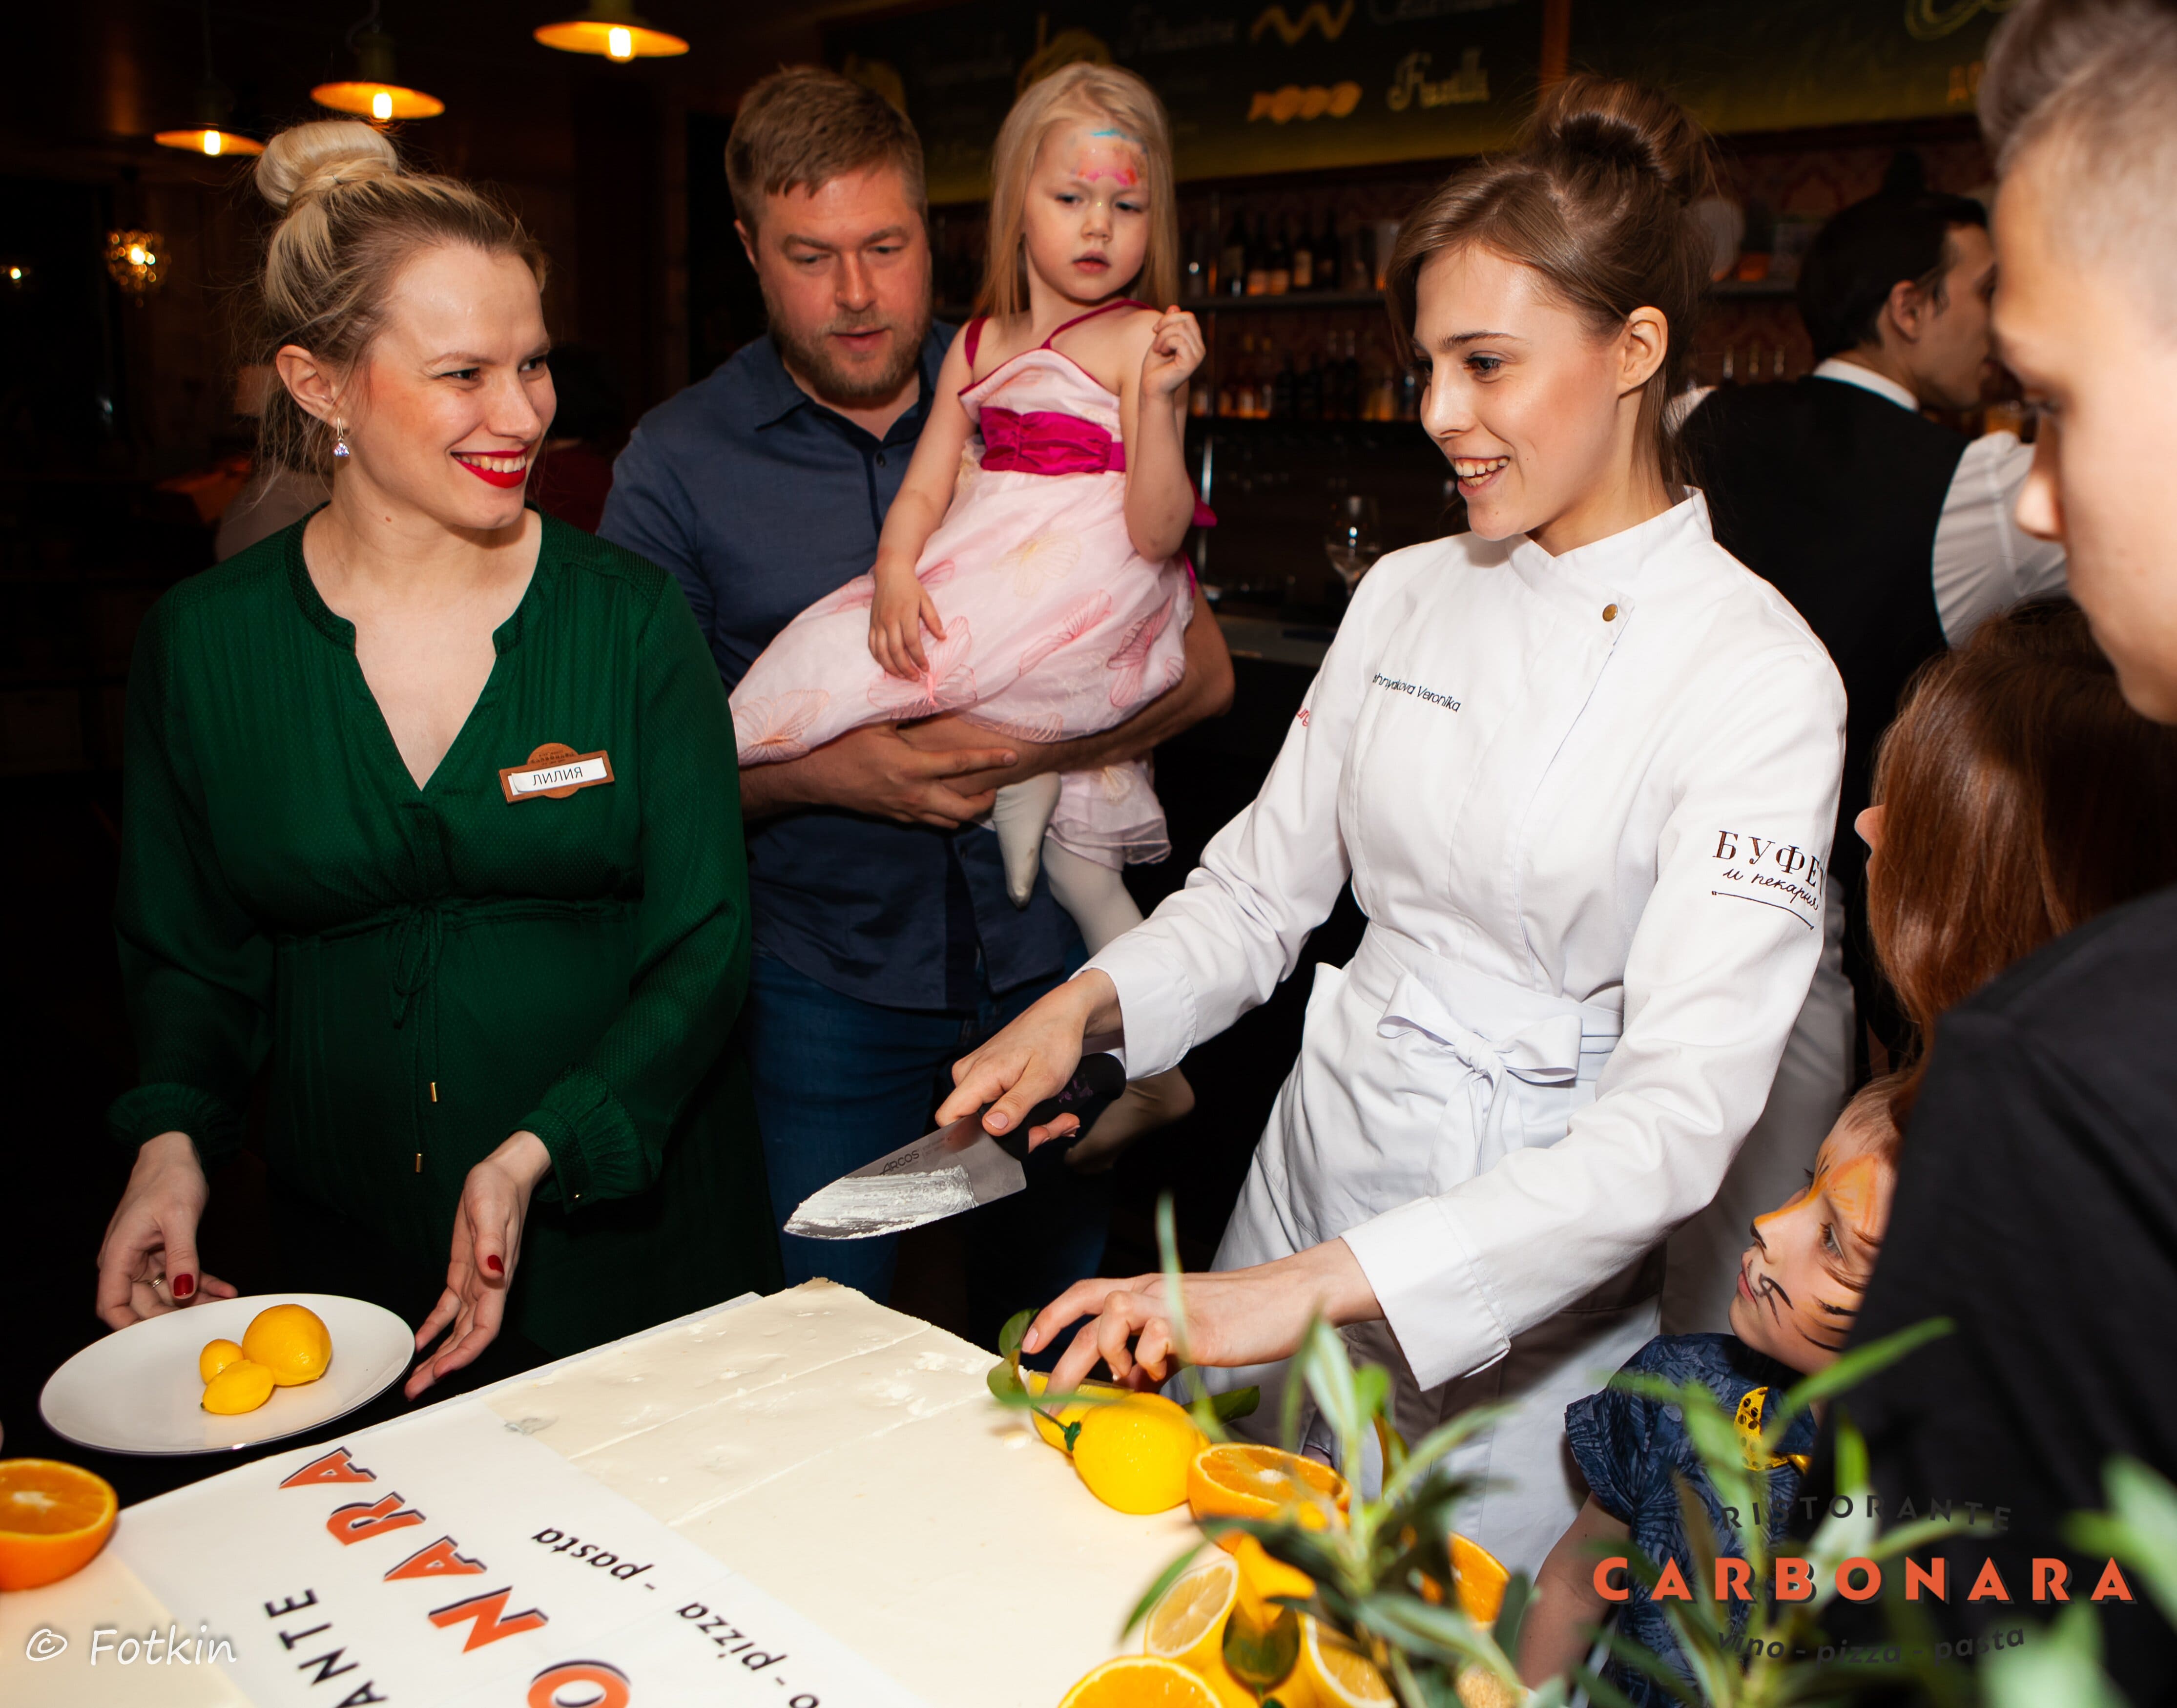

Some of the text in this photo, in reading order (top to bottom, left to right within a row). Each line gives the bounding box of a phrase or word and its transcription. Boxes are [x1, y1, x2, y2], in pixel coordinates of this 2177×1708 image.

[1417, 685, 1461, 712] Veronika
[533, 766, 583, 786] ЛИЛИЯ
[879, 1150, 920, 1175] ARCOS
[531, 1527, 655, 1581] pasta
[676, 1602, 788, 1671] pizza
